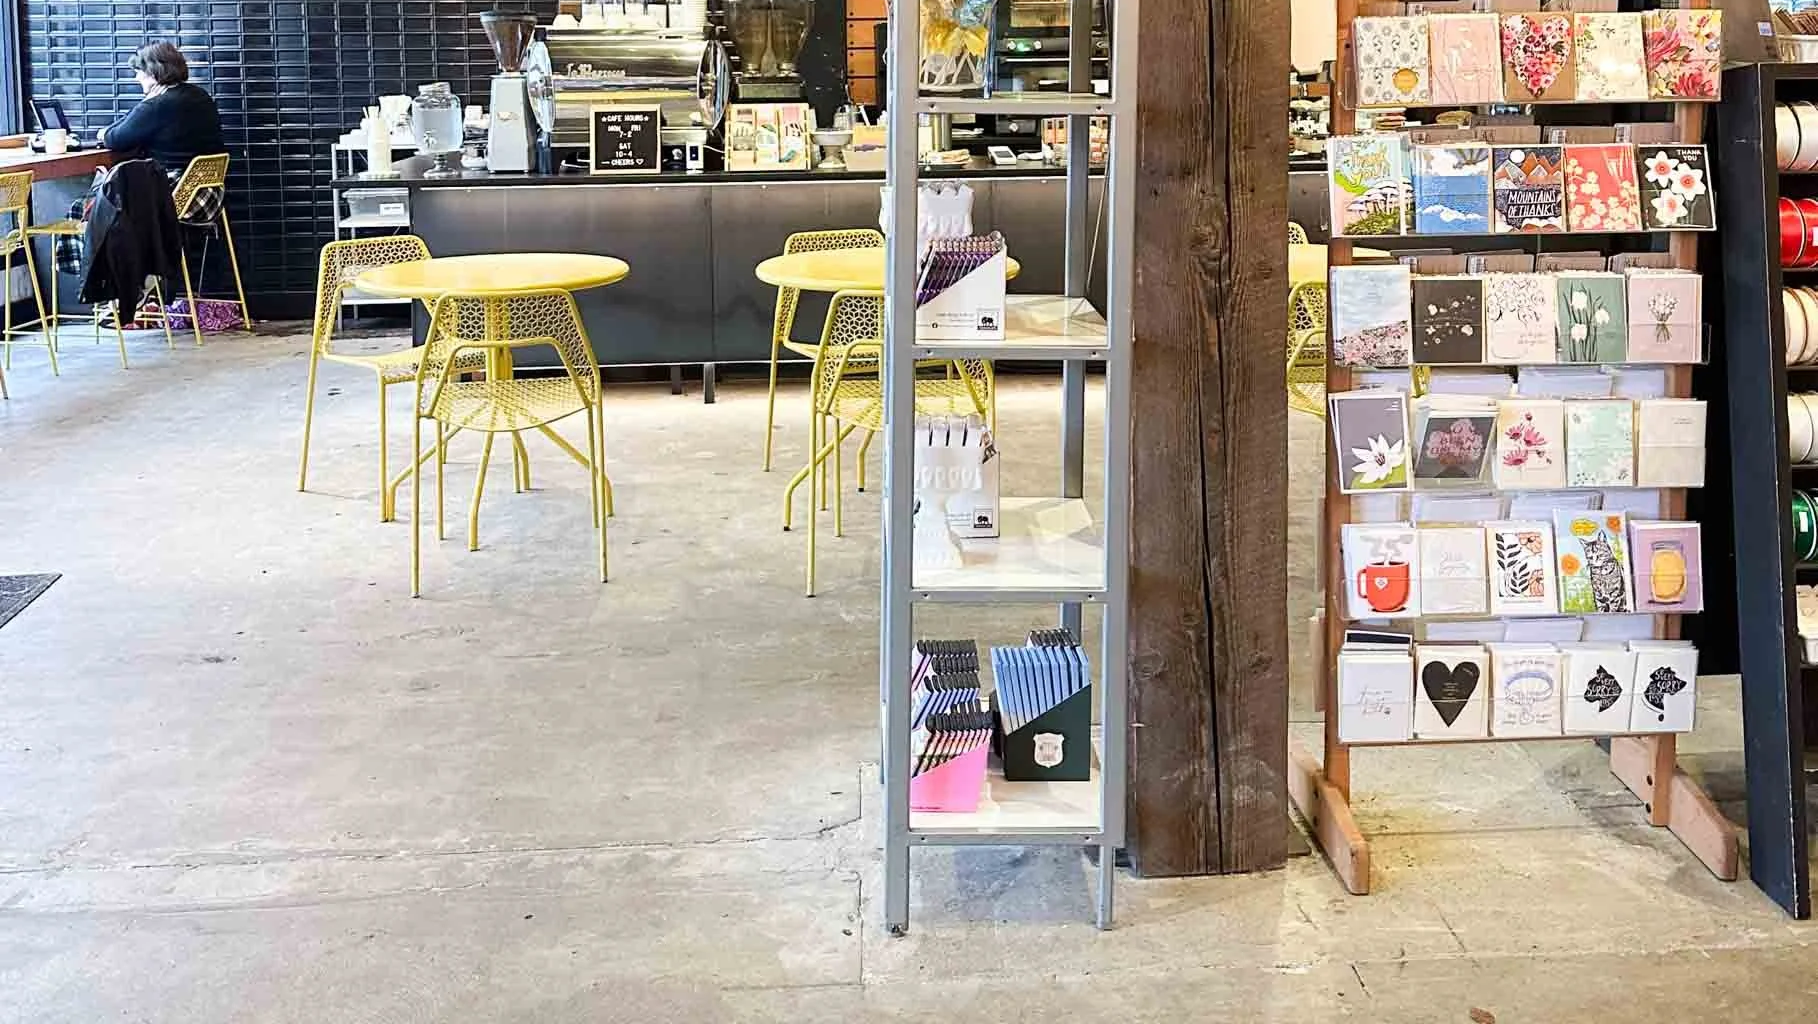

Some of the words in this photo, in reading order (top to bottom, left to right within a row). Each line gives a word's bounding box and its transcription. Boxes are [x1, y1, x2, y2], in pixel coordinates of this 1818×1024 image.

[624, 114, 643, 122] HOURS
[631, 124, 641, 132] FRI
[619, 142, 631, 150] SAT
[615, 150, 633, 158] 10-4
[1507, 189, 1557, 205] MOUNTAINS
[1508, 204, 1519, 218] OF
[1519, 203, 1555, 217] THANKS
[1587, 685, 1611, 696] SORRY
[1657, 681, 1682, 693] SORRY
